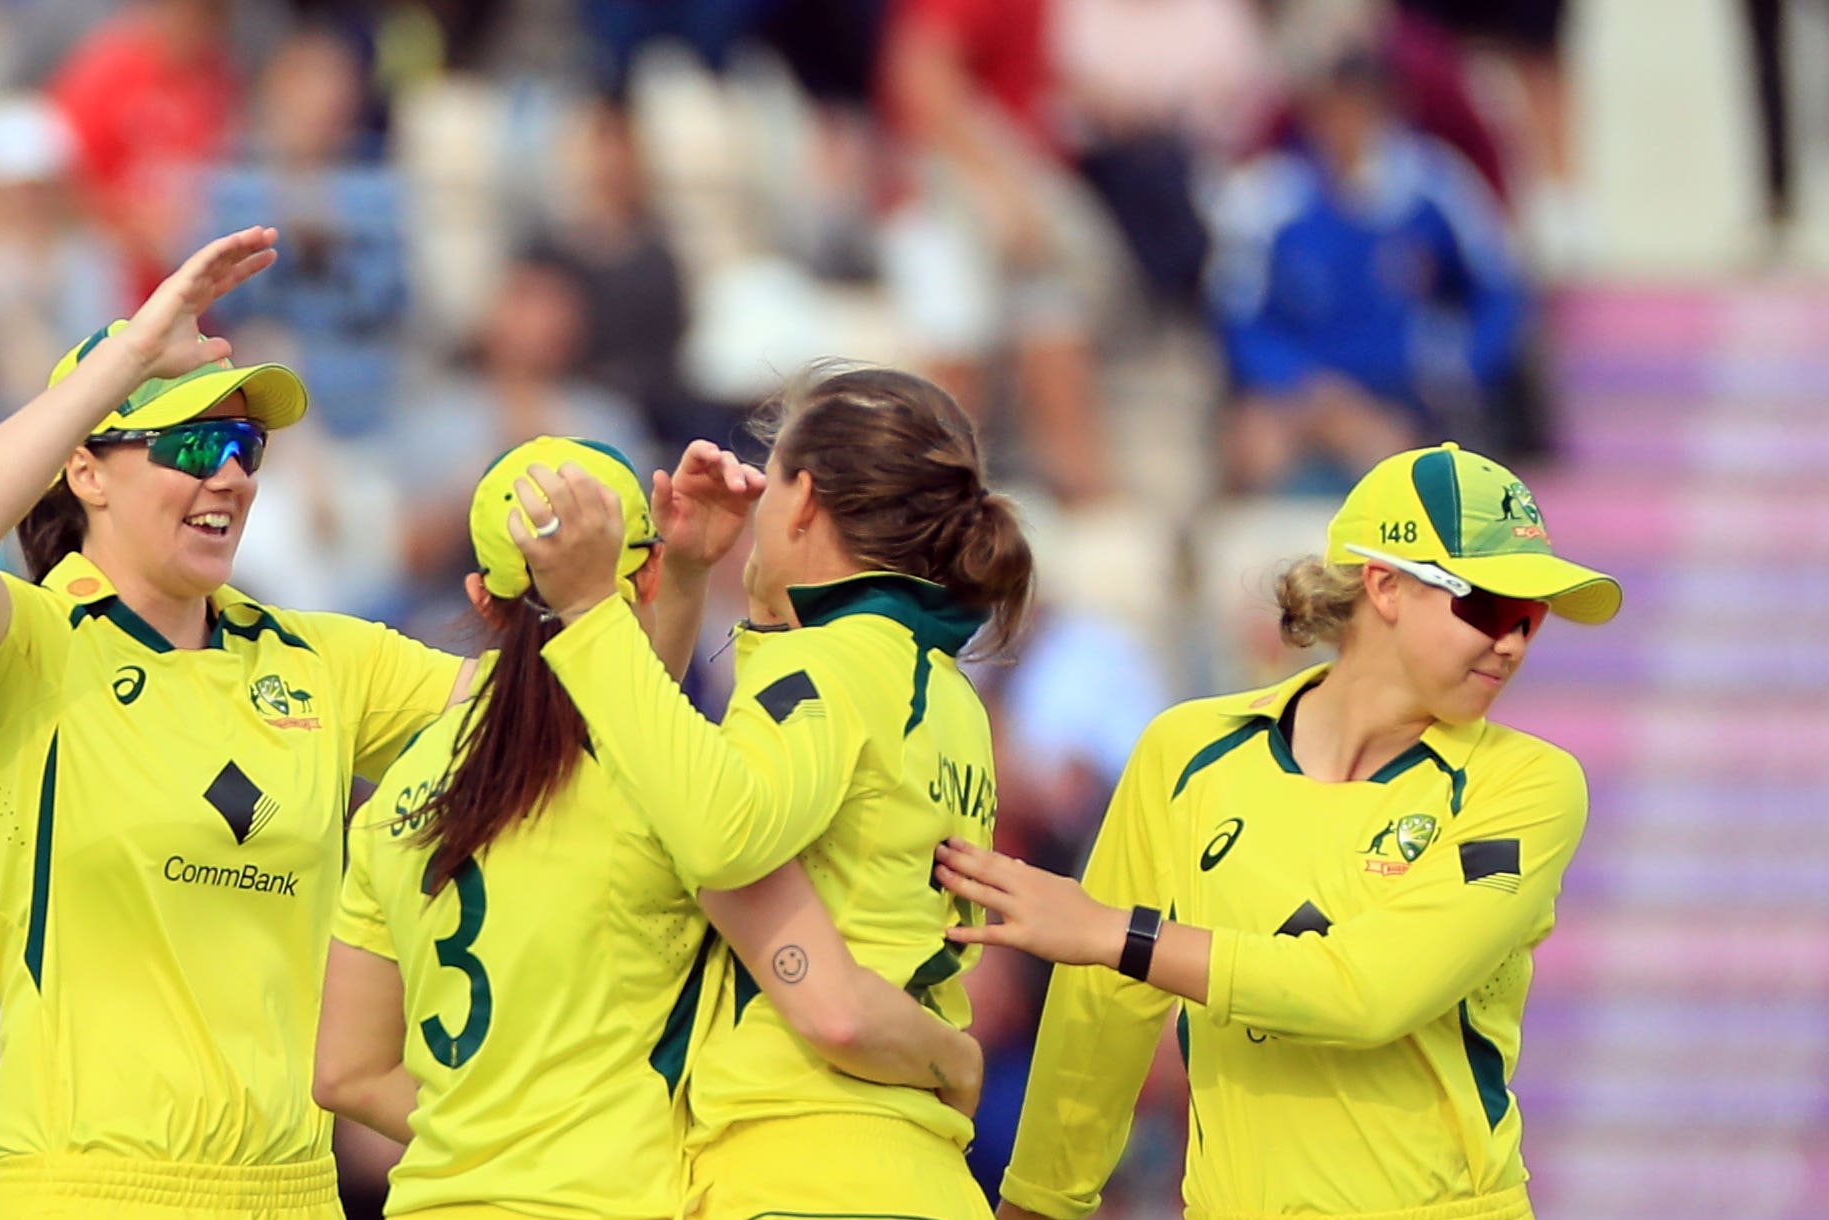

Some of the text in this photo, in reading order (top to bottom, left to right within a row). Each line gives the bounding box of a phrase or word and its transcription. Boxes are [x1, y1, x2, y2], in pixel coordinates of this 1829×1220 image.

[1379, 520, 1418, 544] 148
[163, 855, 300, 897] CommBank
[420, 838, 493, 1069] 3
